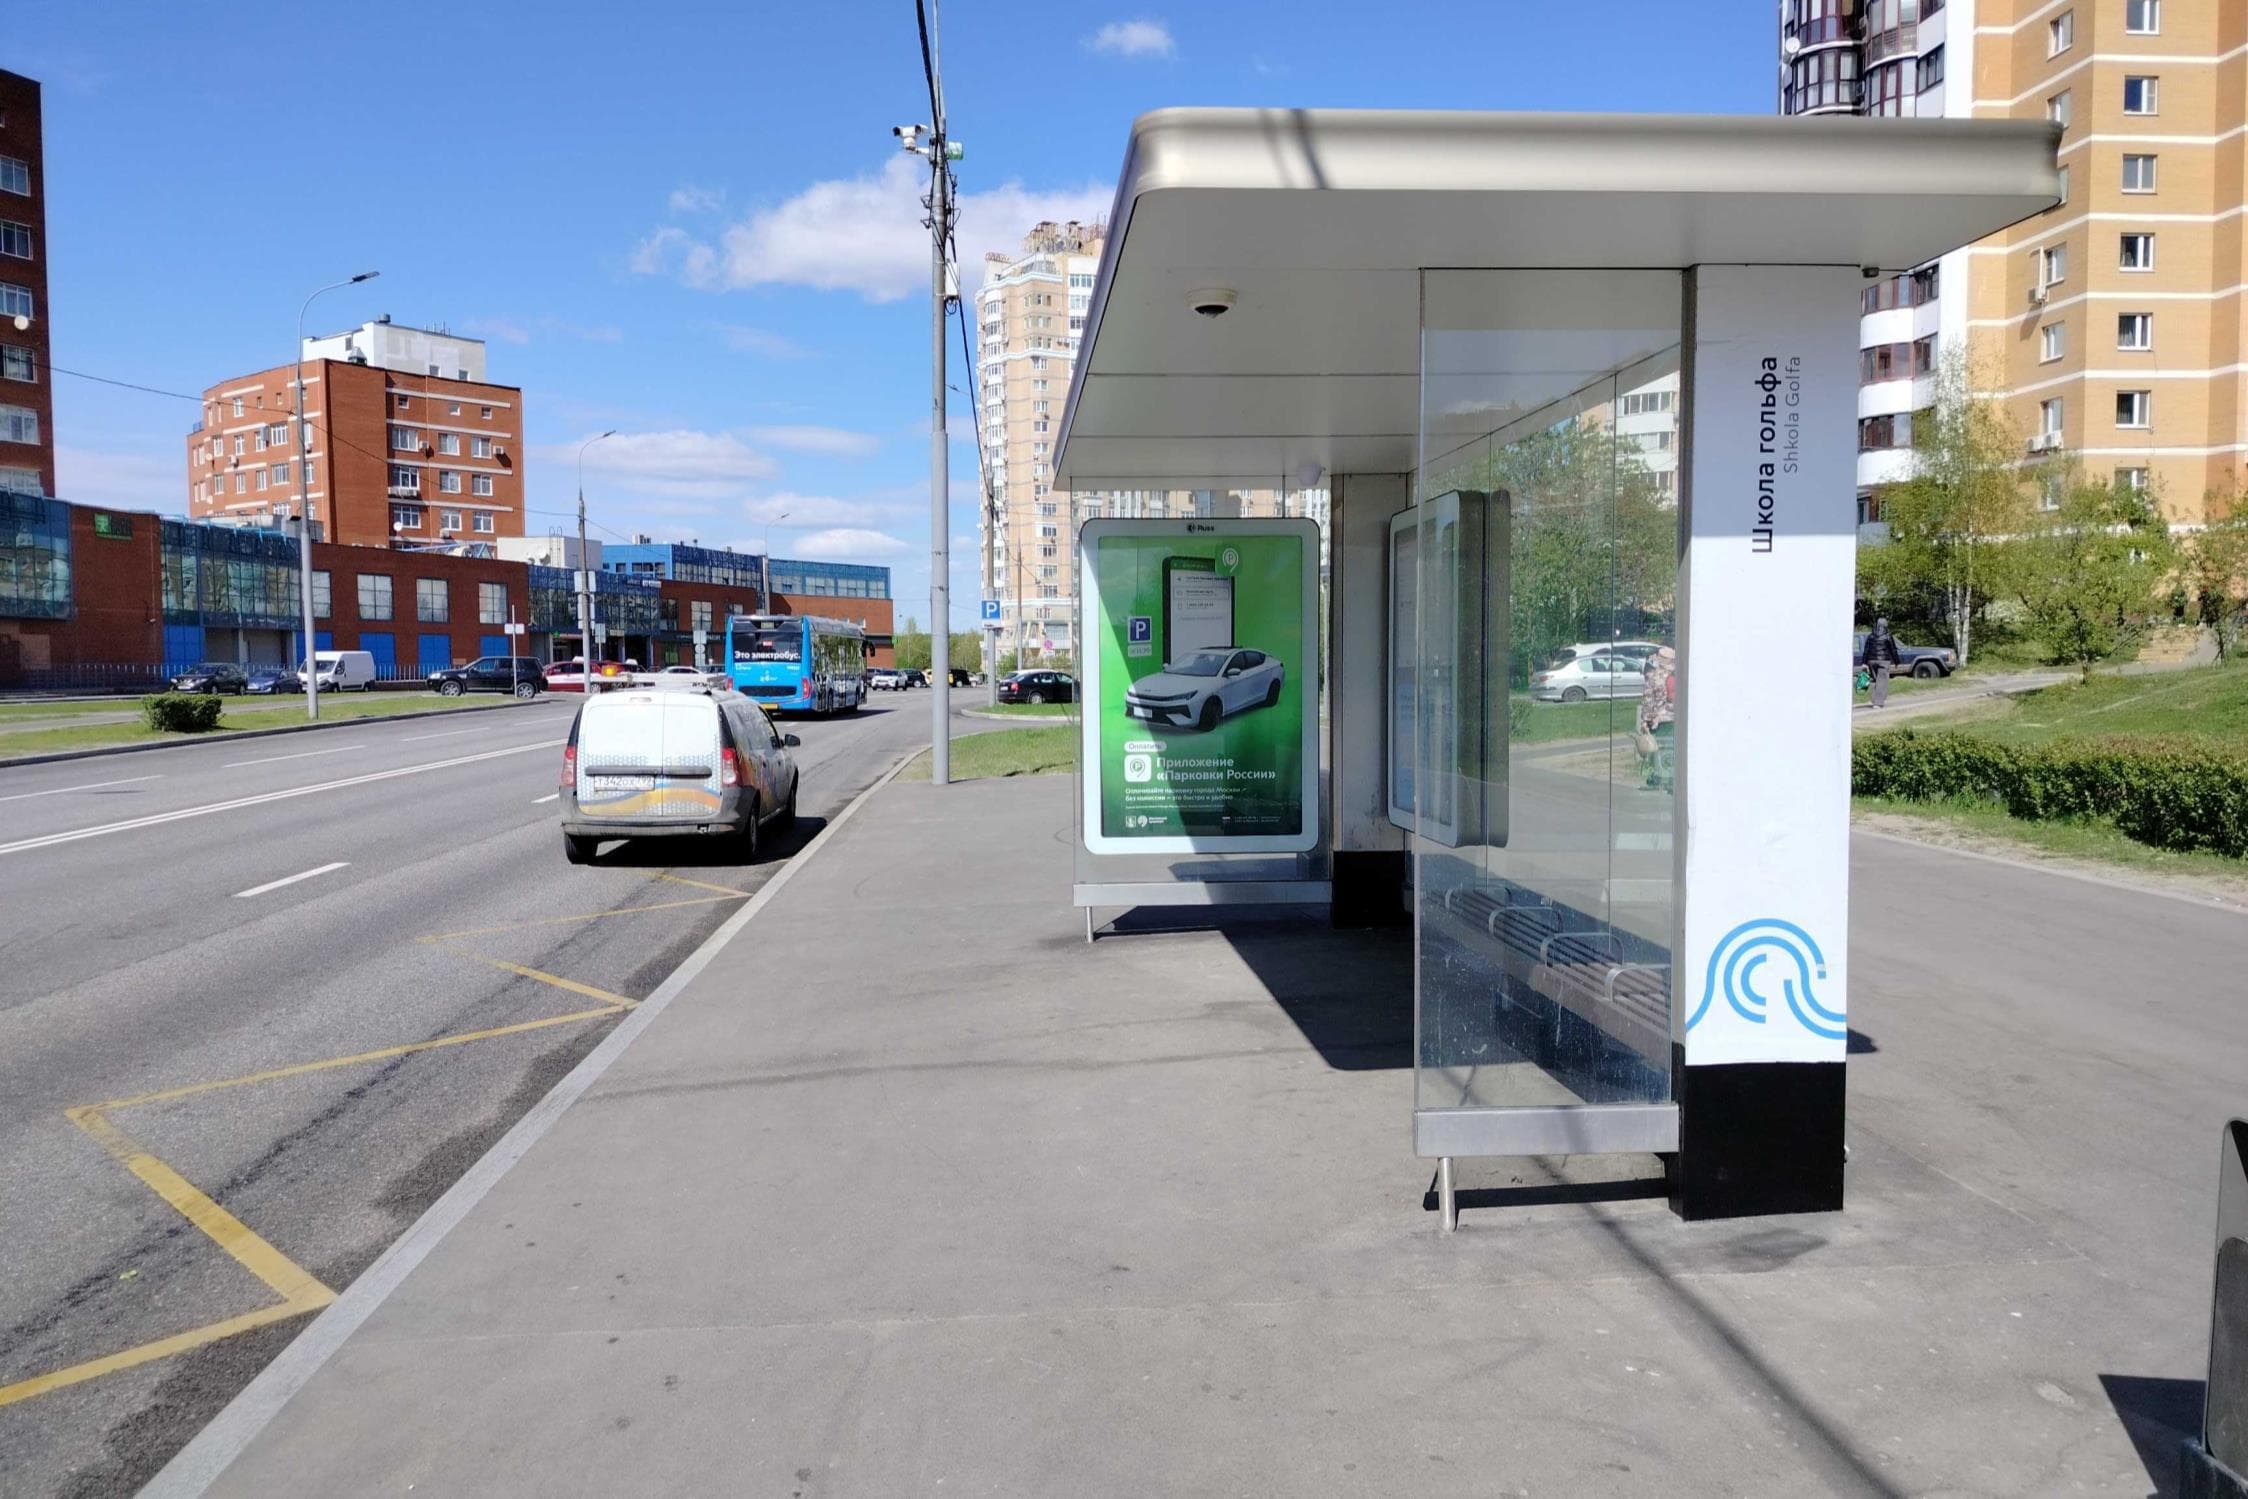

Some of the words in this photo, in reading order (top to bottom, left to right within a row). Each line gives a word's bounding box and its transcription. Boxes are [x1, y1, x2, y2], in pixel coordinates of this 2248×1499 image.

[1785, 356, 1801, 407] Golfa
[1754, 357, 1782, 453] гольфа
[1783, 413, 1799, 474] Shkola
[1752, 463, 1775, 553] Школа
[986, 602, 998, 618] P
[1135, 621, 1147, 640] P
[734, 651, 750, 660] Это
[751, 650, 801, 661] электробус.
[1128, 743, 1162, 751] Оплатить
[1156, 757, 1235, 770] Приложение
[1156, 770, 1224, 782] «Парковки
[1226, 769, 1276, 780] России»
